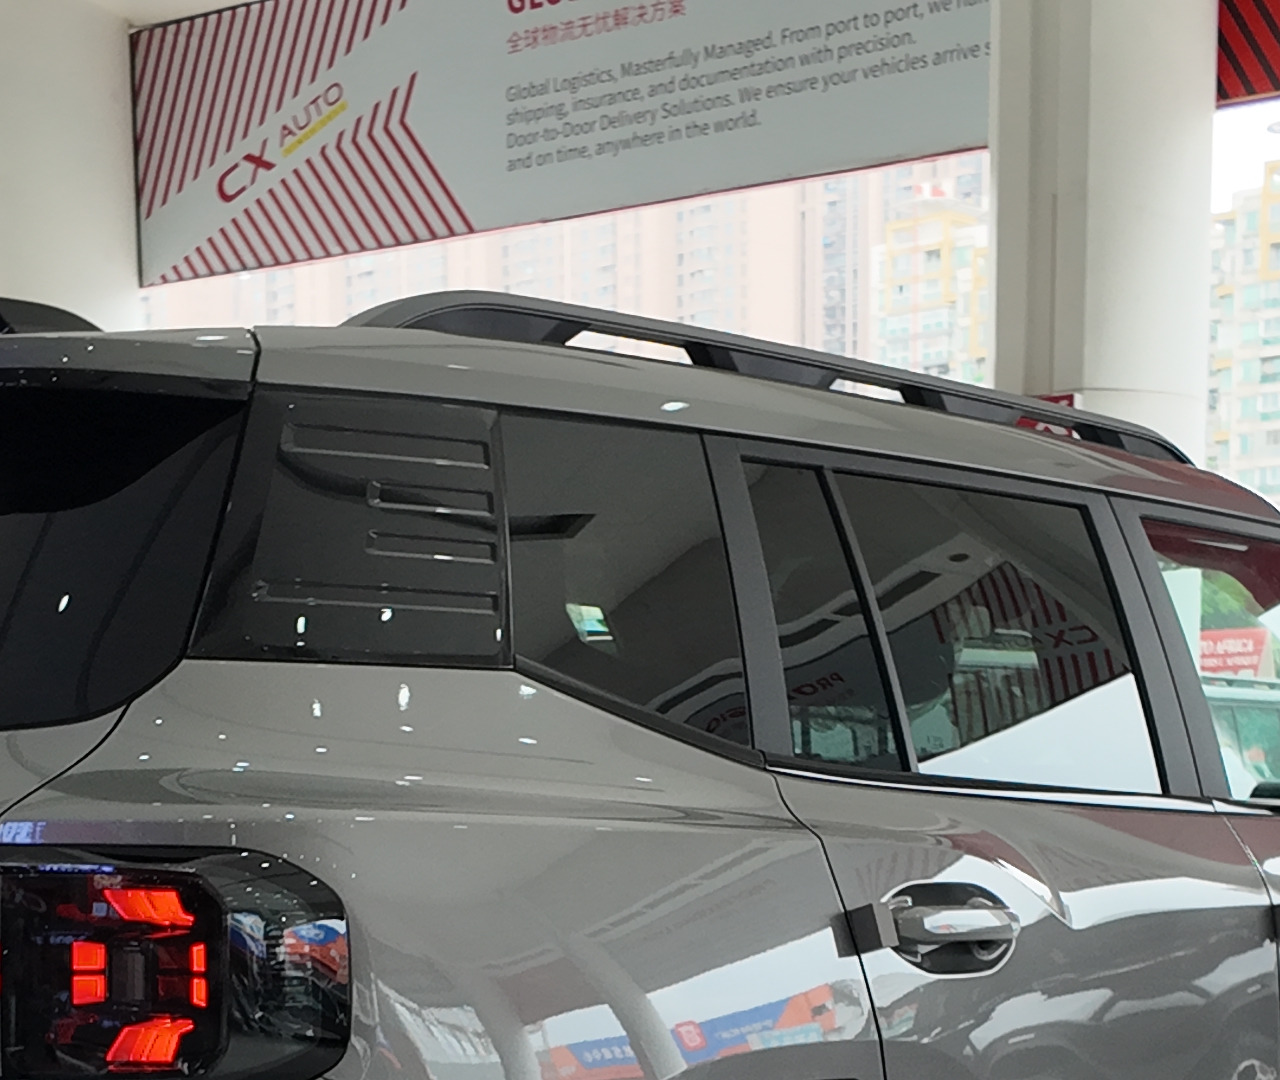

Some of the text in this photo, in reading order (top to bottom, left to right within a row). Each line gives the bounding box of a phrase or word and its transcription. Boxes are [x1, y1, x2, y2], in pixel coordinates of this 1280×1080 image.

[505, 78, 551, 103] Global
[553, 68, 618, 94] Logistics,
[620, 48, 701, 79] Masterfully
[703, 31, 777, 60] Managed.
[781, 27, 821, 45] From
[825, 15, 860, 41] port
[863, 13, 881, 29] to
[883, 2, 924, 28] port,
[506, 31, 916, 126] shipping, insurance, and documentation with precision.
[506, 121, 597, 149] Door-to-Door
[599, 107, 658, 131] Delivery
[660, 93, 735, 120] Solutions.
[738, 86, 762, 104] We
[765, 75, 819, 97] ensure
[822, 69, 859, 93] your
[862, 53, 928, 80] vehicles
[931, 43, 981, 66] arrive
[216, 137, 277, 203] CX
[279, 82, 344, 148] AUTO
[506, 109, 761, 172] and on time, anywhere in the world.
